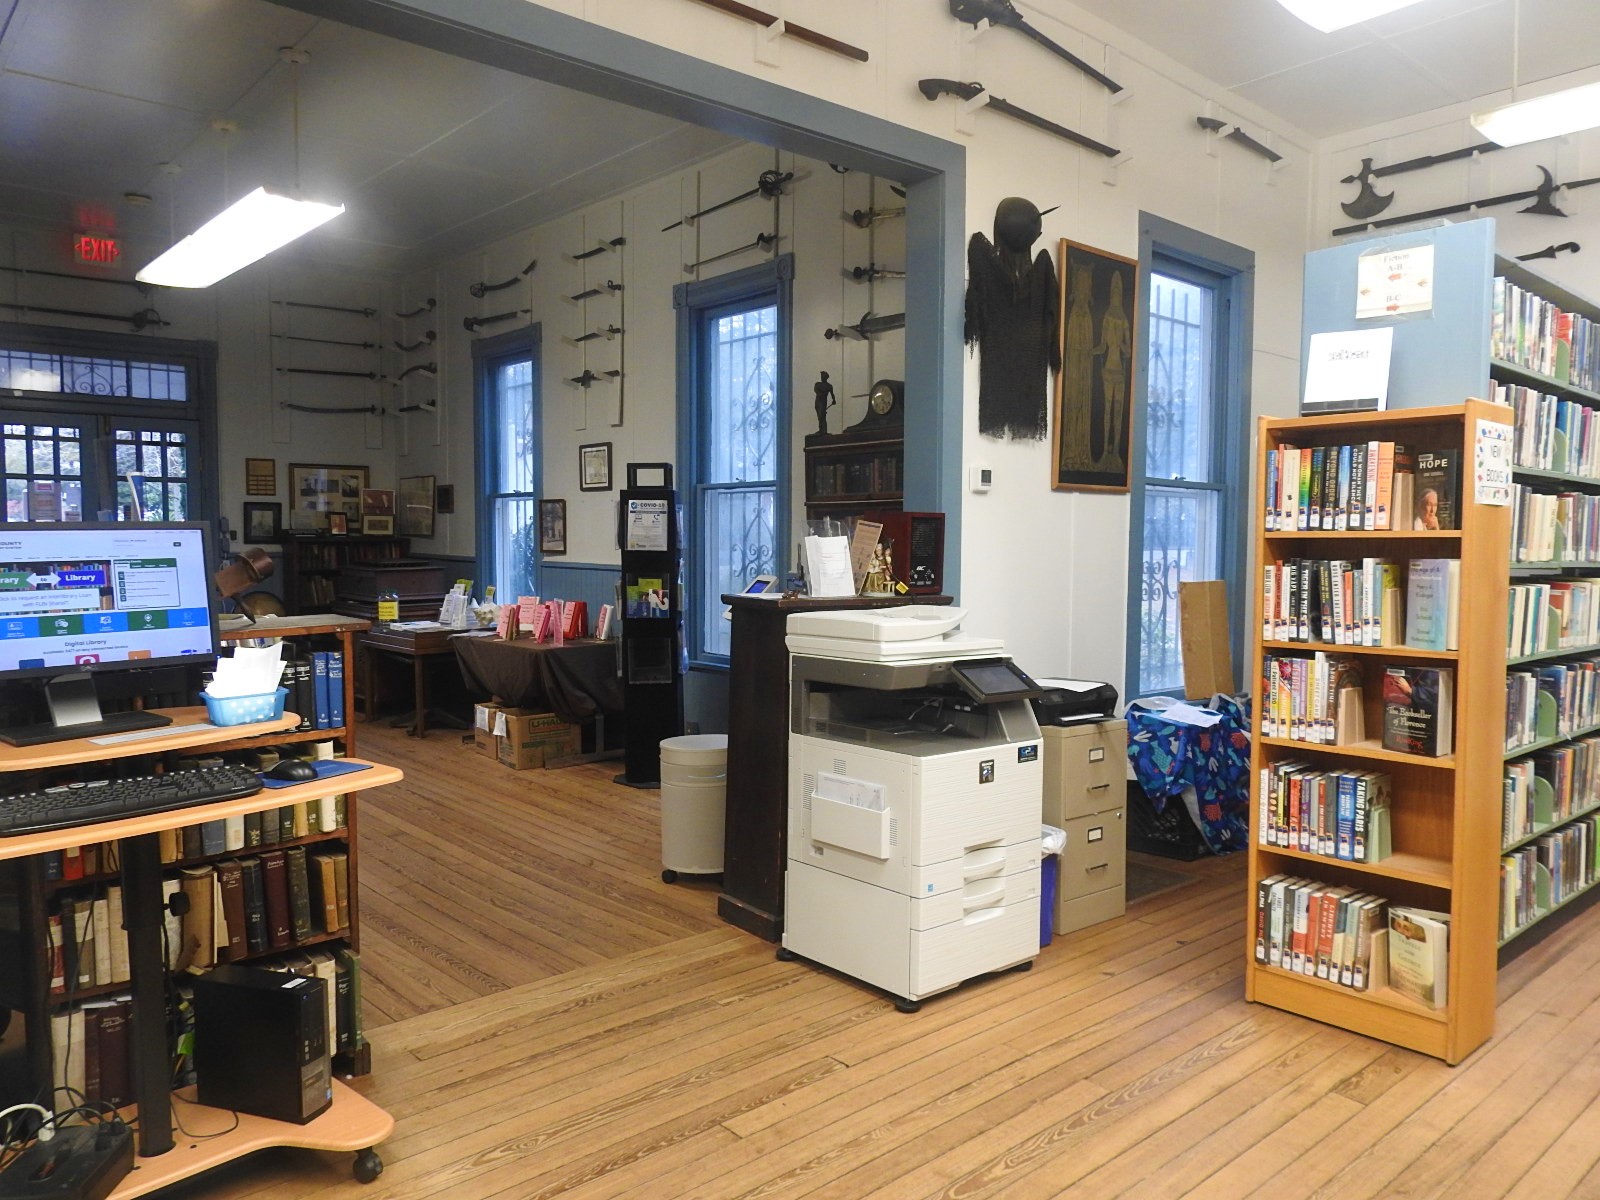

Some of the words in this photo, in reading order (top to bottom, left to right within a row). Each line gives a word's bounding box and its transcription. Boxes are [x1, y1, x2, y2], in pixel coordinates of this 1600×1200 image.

[81, 237, 115, 262] EXIT
[1329, 451, 1338, 477] BEYOND
[1366, 449, 1376, 482] AWAKENING
[1420, 458, 1448, 469] HOPE
[1328, 479, 1337, 502] ORDER
[65, 574, 96, 582] Library
[1301, 569, 1309, 590] TIGER
[1300, 600, 1308, 614] THE
[86, 639, 107, 647] Library
[1386, 706, 1399, 715] The
[1400, 707, 1432, 720] Bookseller
[1400, 717, 1427, 729] Florence
[1356, 781, 1366, 809] TAKING
[1355, 809, 1364, 832] PARIS
[1320, 911, 1328, 938] SWEET
[1326, 904, 1335, 938] LIBERTY
